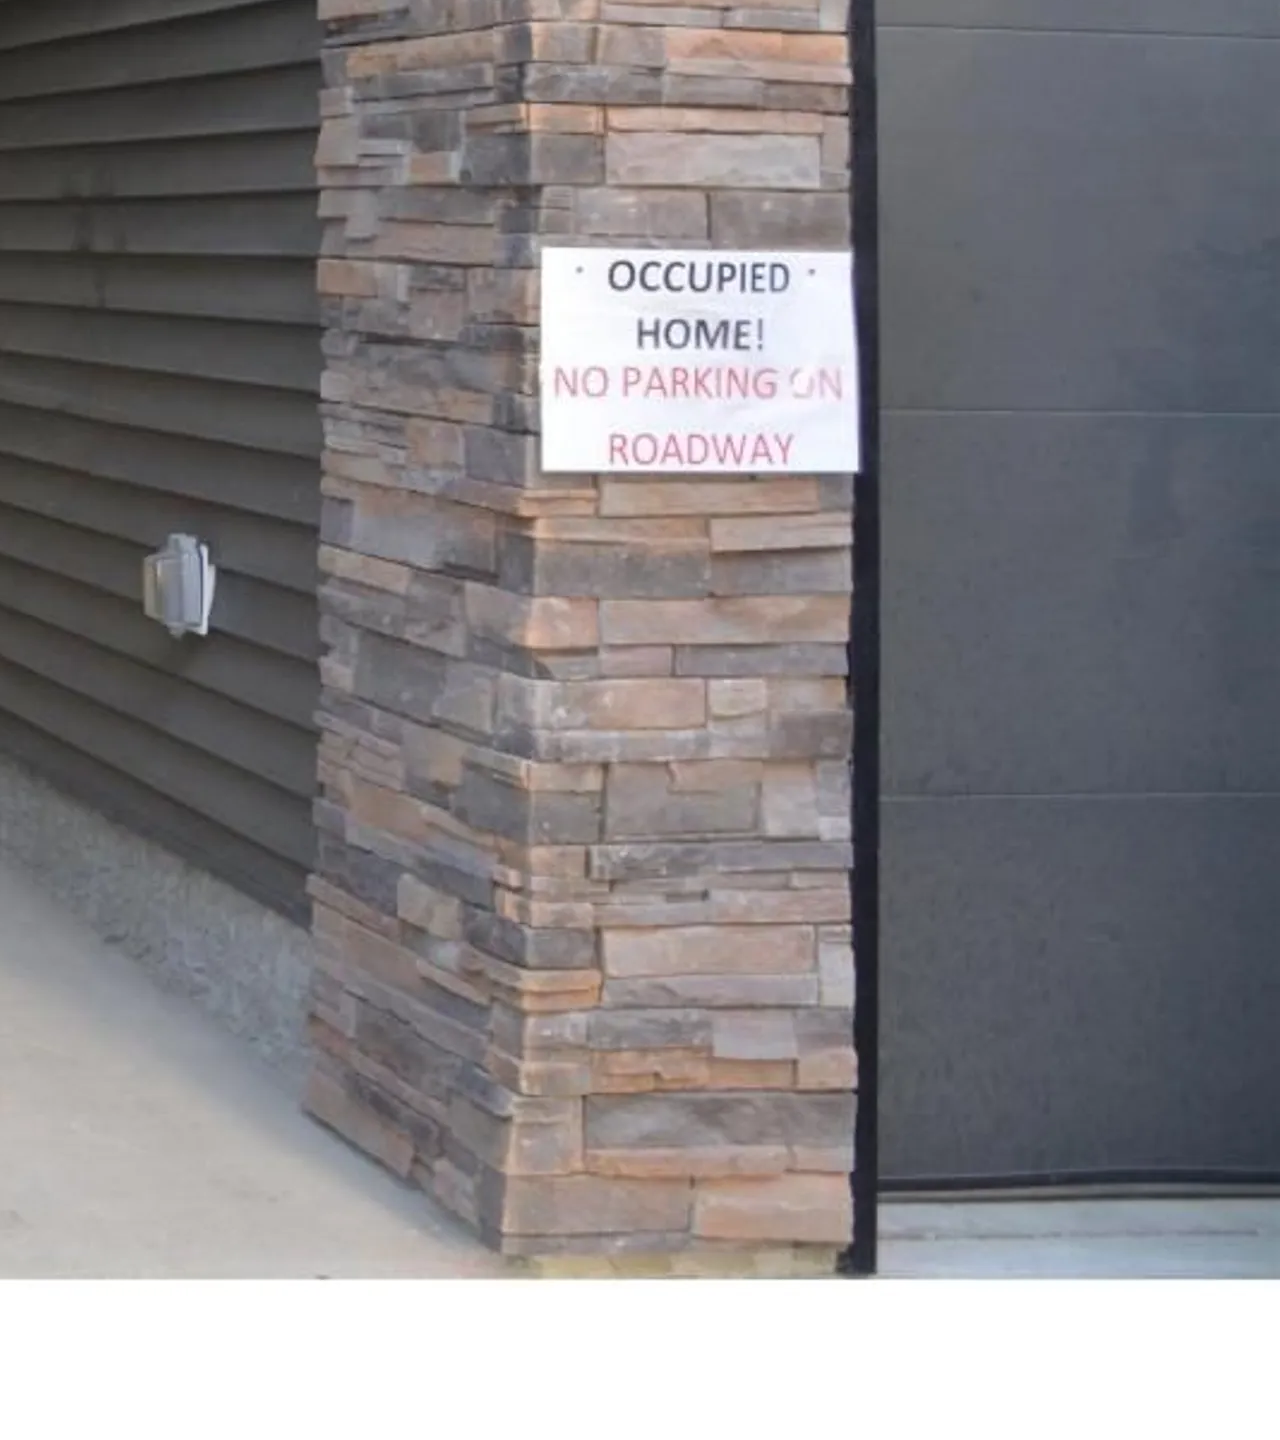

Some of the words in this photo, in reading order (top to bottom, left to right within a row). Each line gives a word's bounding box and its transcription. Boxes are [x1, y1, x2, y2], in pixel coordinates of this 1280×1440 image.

[607, 259, 790, 293] OCCUPIED
[636, 317, 764, 350] HOME!
[553, 366, 609, 398] NO
[621, 366, 778, 400] PARKING
[790, 367, 844, 400] ON
[608, 433, 795, 466] ROADWAY
